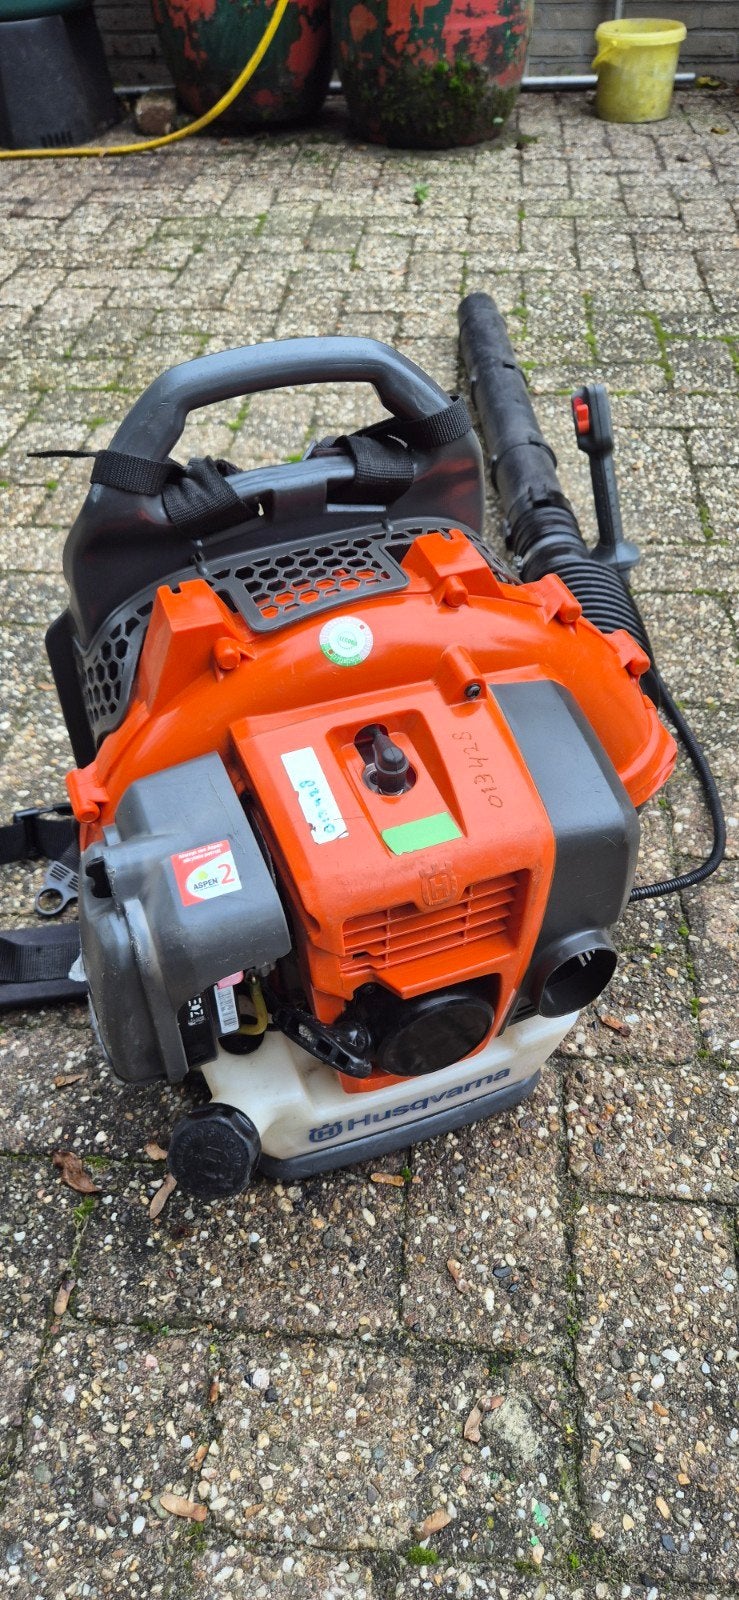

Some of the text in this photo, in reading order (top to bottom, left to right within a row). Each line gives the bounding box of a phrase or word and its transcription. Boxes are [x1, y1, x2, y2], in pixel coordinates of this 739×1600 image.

[451, 731, 503, 808] 013428
[193, 877, 218, 890] ASPEN
[217, 863, 235, 884] 2
[347, 1067, 511, 1131] Husqvarna
